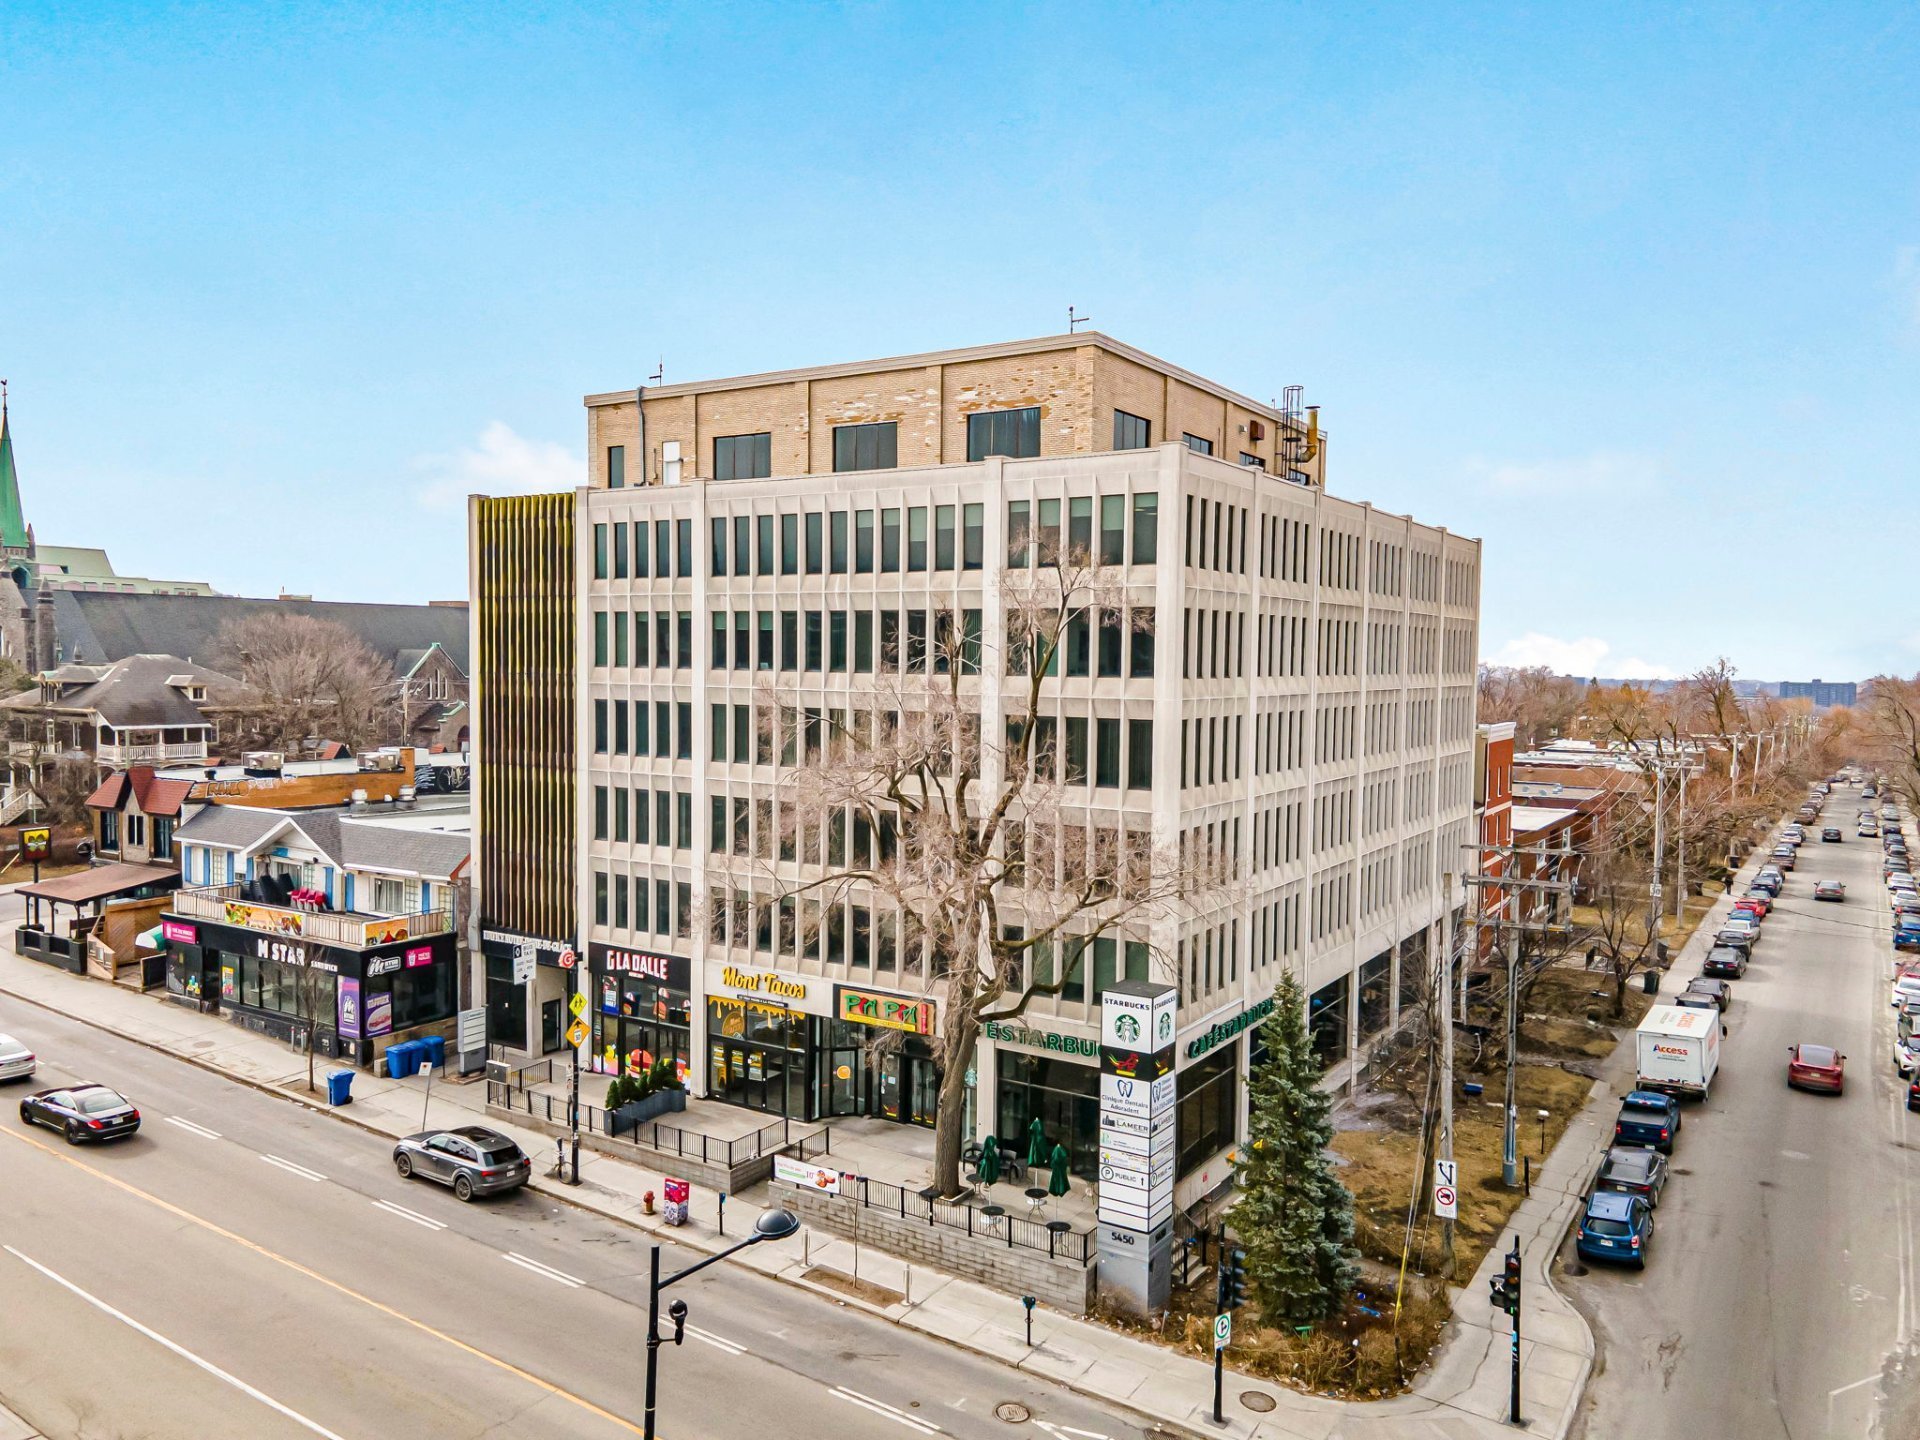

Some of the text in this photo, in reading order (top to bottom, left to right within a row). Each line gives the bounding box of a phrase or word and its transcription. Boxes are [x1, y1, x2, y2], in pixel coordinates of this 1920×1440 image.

[257, 938, 269, 959] M
[631, 954, 669, 980] DALLE
[722, 966, 806, 1004] Mont Tacos
[1103, 998, 1151, 1011] STARBUCKS
[1154, 996, 1176, 1010] STARBUCKS
[1653, 1044, 1688, 1056] Access
[1111, 1231, 1135, 1246] 5450
